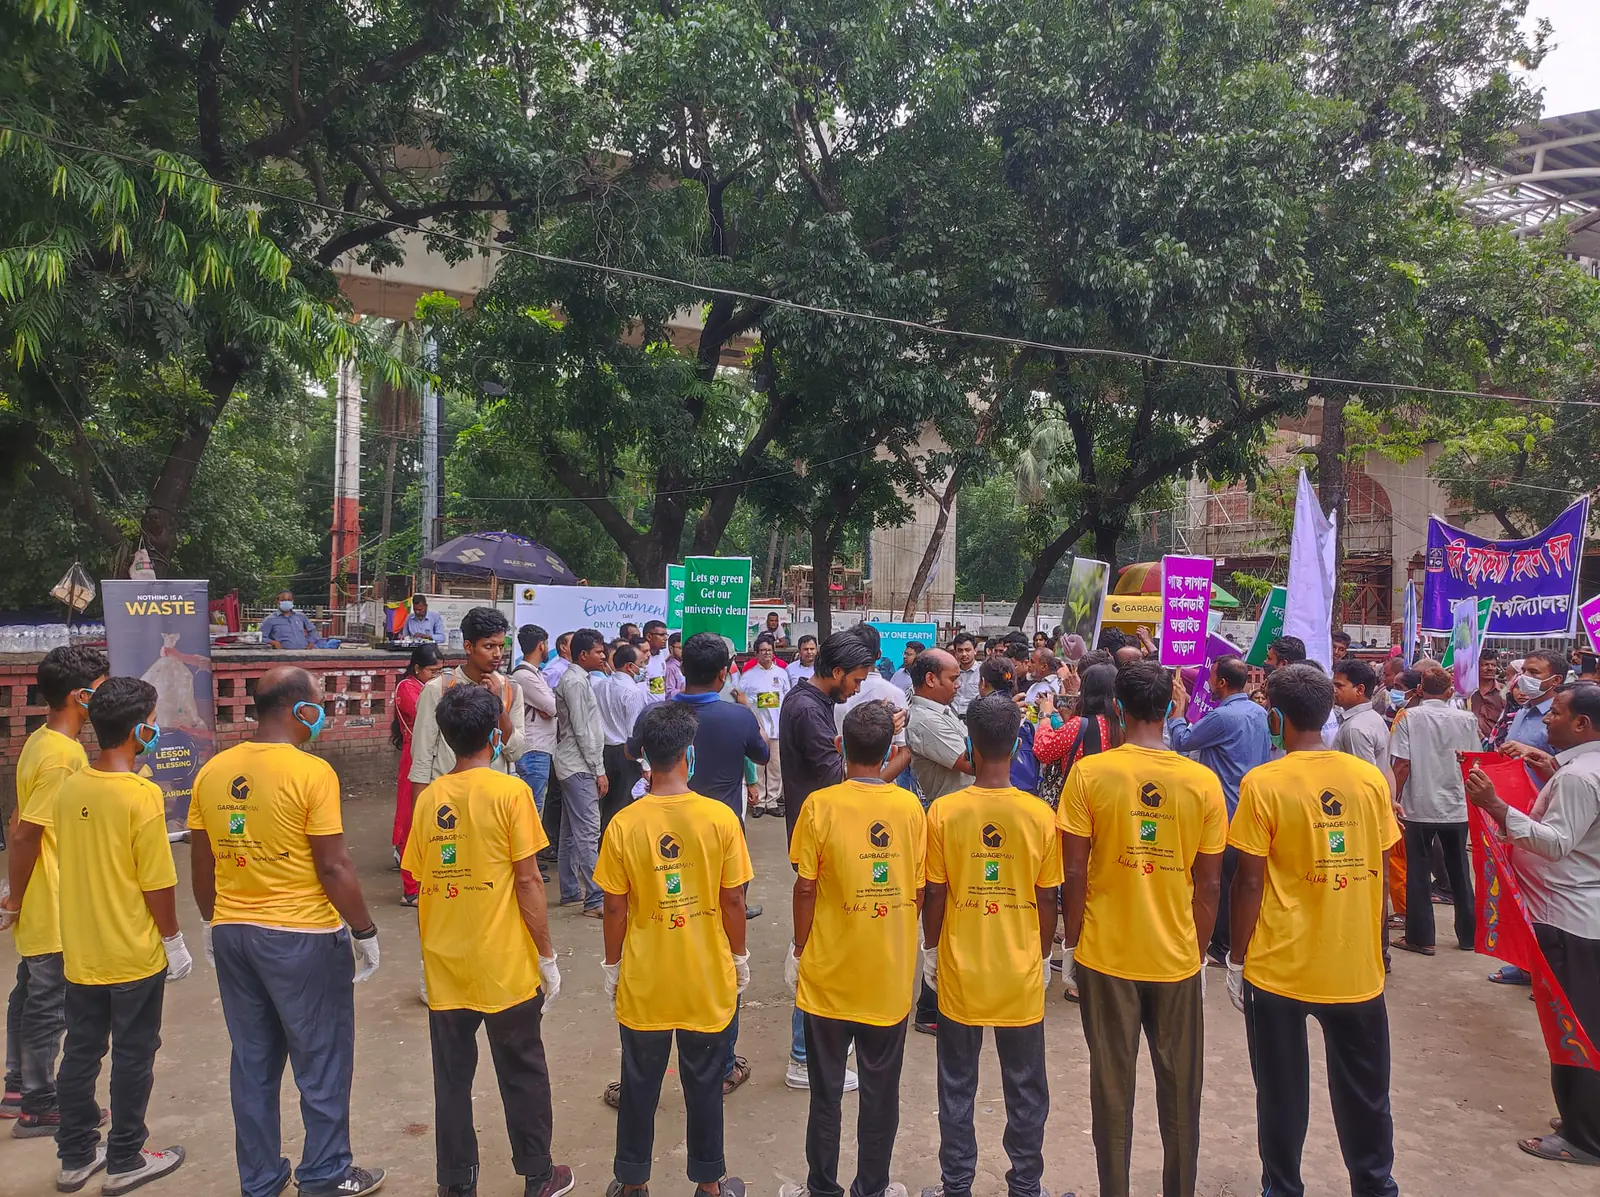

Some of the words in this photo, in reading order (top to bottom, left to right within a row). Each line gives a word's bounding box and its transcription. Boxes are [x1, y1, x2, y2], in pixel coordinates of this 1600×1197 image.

[690, 572, 708, 582] Lets
[709, 575, 719, 585] go
[721, 575, 743, 585] green
[1168, 575, 1183, 592] গাছ
[1184, 576, 1209, 591] লাগান
[700, 588, 715, 598] Get
[717, 591, 732, 599] our
[125, 601, 196, 616] WASTE
[684, 604, 723, 617] university
[725, 605, 747, 616] clean
[908, 632, 933, 640] EARTH
[1171, 640, 1197, 656] তাড়ান
[155, 749, 190, 759] LESSON
[156, 760, 191, 770] BLESSING
[971, 852, 1015, 860] GARBAGEMAN
